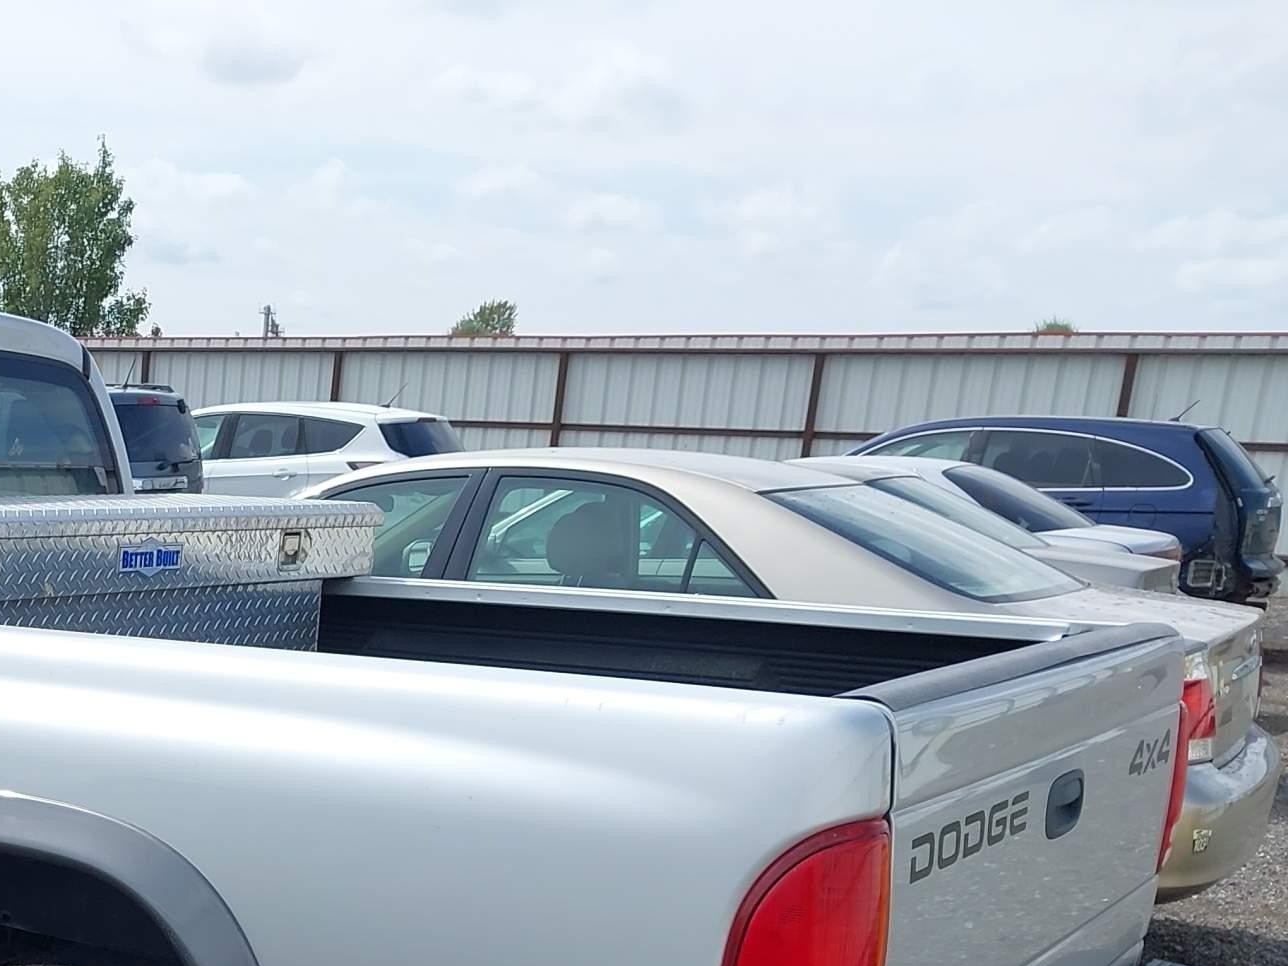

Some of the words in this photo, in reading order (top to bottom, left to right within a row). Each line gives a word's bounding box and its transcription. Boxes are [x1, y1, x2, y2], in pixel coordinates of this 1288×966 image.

[122, 550, 154, 568] BETTER
[156, 548, 180, 567] BUILT
[909, 790, 1030, 884] DODGE
